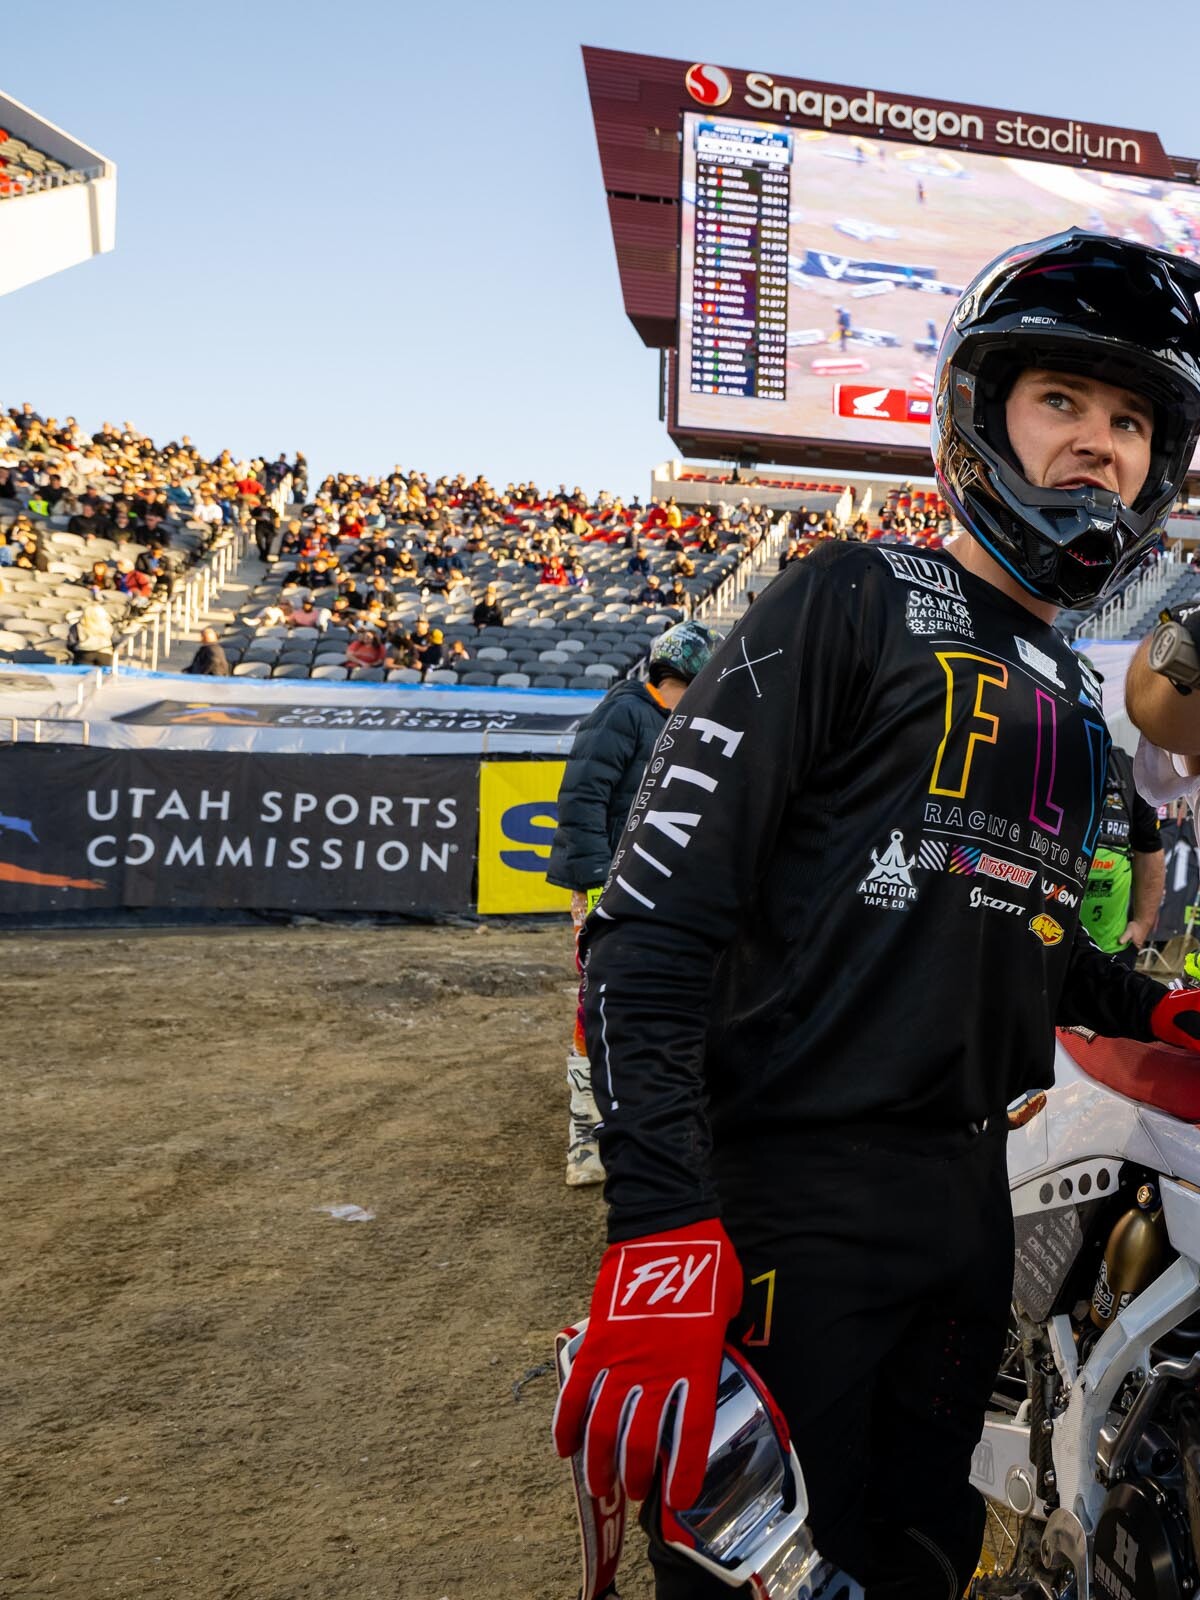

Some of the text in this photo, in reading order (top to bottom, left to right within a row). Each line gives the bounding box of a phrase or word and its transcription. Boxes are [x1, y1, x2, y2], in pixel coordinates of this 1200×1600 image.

[744, 73, 1141, 165] Snapdragon stadium
[1021, 315, 1057, 325] RHEON
[908, 590, 951, 611] S&W
[908, 608, 972, 629] MACHINERY
[929, 619, 976, 639] SERVICE
[278, 714, 508, 730] COMMISSION
[87, 788, 458, 829] UTAH SPORTS
[924, 803, 1020, 842] RACING
[858, 880, 917, 900] ANCHOR
[864, 896, 905, 910] TAPE CO
[1027, 1236, 1059, 1274] DEVOL
[621, 1252, 712, 1306] FLY
